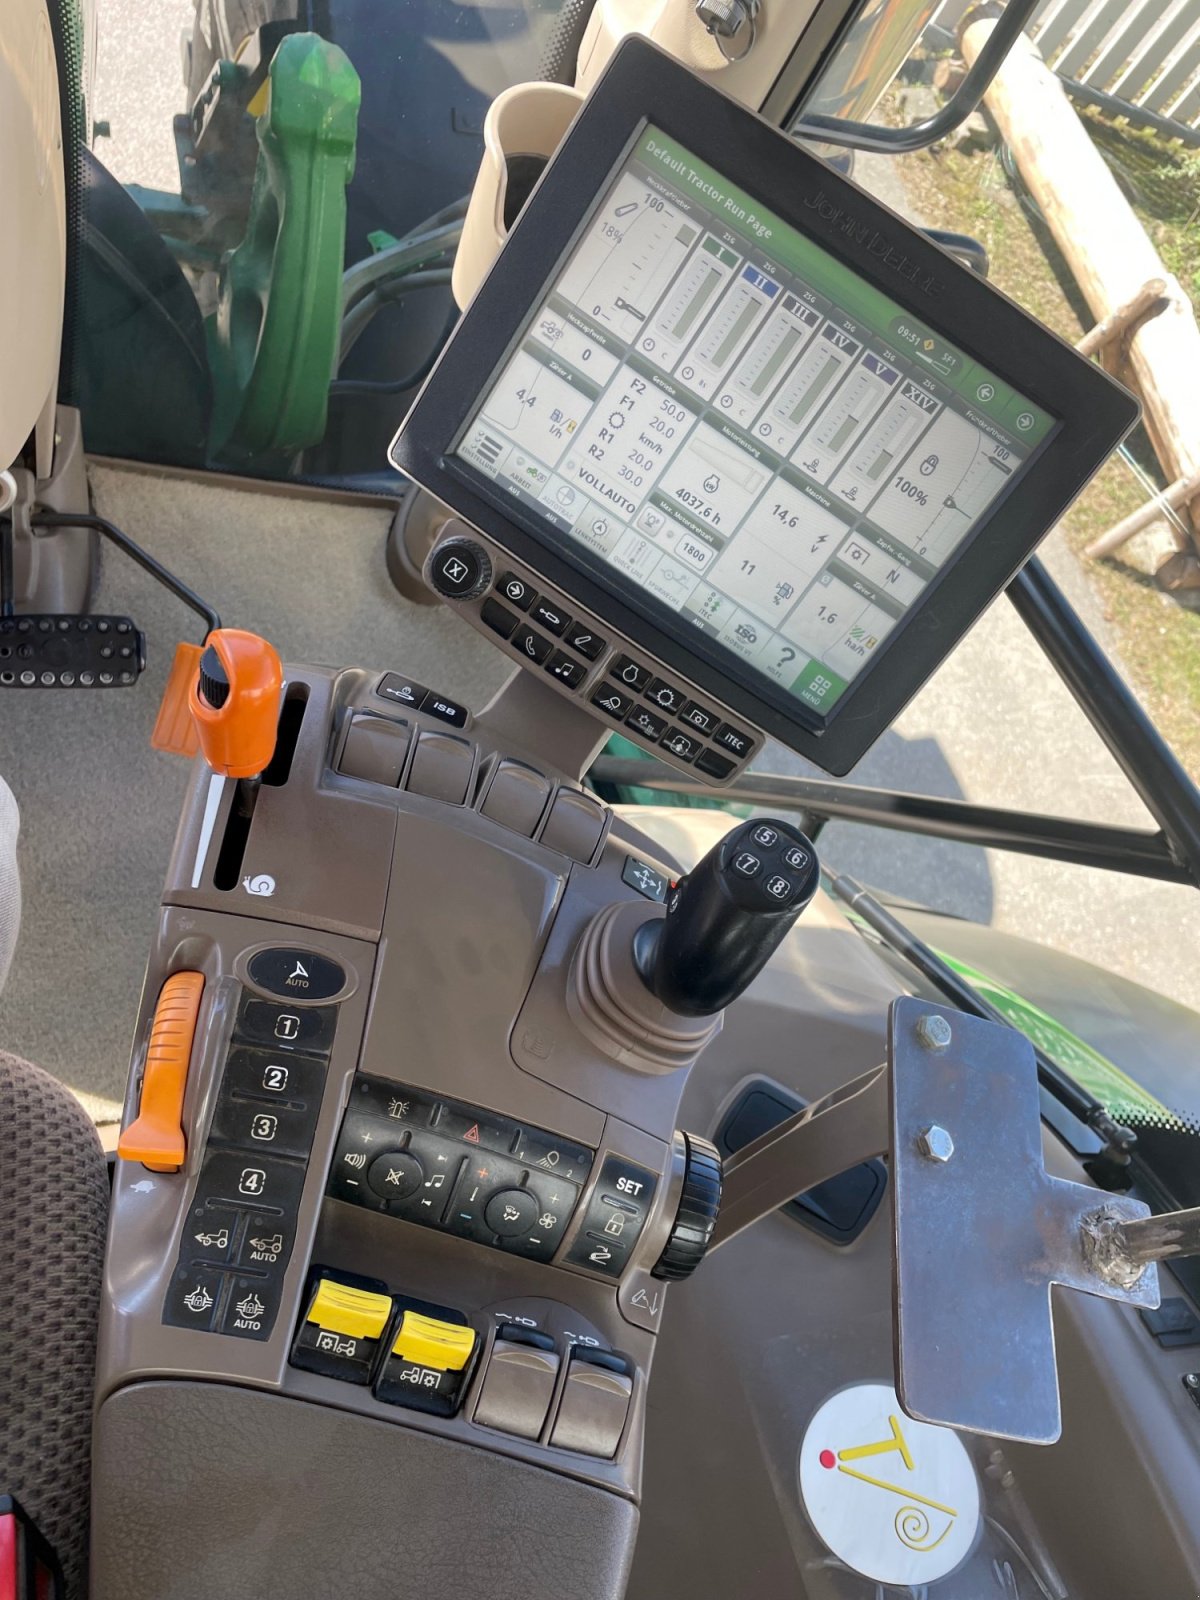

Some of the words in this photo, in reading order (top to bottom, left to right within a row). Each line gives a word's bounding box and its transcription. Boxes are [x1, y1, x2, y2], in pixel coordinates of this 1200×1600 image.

[646, 140, 687, 176] Default
[686, 170, 724, 203] Tractor
[723, 198, 746, 219] Run
[746, 215, 772, 240] Page
[644, 193, 665, 212] 100
[601, 221, 624, 244] 18%
[715, 247, 724, 259] I
[753, 274, 768, 290] II
[592, 305, 601, 316] 0
[790, 301, 810, 321] III
[831, 331, 851, 349] IV
[897, 325, 921, 346] 09:51
[582, 349, 592, 361] 0
[941, 352, 957, 366] SF1
[874, 362, 889, 376] V
[630, 378, 647, 396] F2
[515, 388, 537, 408] 4,4
[619, 395, 635, 411] F1
[904, 385, 935, 410] XIV
[660, 399, 686, 423] 50.0
[598, 427, 615, 444] R1
[649, 416, 675, 440] 20.0
[588, 443, 605, 461] R2
[638, 432, 663, 455] km/h
[628, 449, 654, 472] 20.0
[993, 445, 1010, 461] 100
[617, 464, 643, 488] 30.0
[578, 467, 636, 514] VOLLAUTO
[805, 486, 832, 508] Maschine
[894, 476, 929, 507] 100%
[675, 488, 713, 517] 4037,6
[712, 512, 722, 526] h
[771, 504, 800, 528] 14,6
[682, 542, 706, 563] 1800
[919, 547, 927, 556] 0
[740, 560, 756, 576] 11
[886, 569, 900, 584] N
[816, 605, 838, 625] 1,6
[734, 623, 757, 644] ISO
[844, 638, 866, 657] ha/h
[433, 701, 456, 716] ISB
[761, 831, 773, 843] 5
[743, 857, 754, 869] 7
[791, 853, 803, 865] 6
[772, 880, 785, 894] 8
[285, 978, 310, 989] AUTO
[283, 1020, 292, 1035] 1
[268, 1071, 282, 1087] 2
[257, 1120, 271, 1136] 3
[519, 1151, 525, 1159] 1
[566, 1169, 573, 1178] 2
[245, 1174, 258, 1191] 4
[616, 1176, 643, 1196] SET
[250, 1251, 277, 1263] AUTO
[233, 1319, 261, 1331] AUTO
